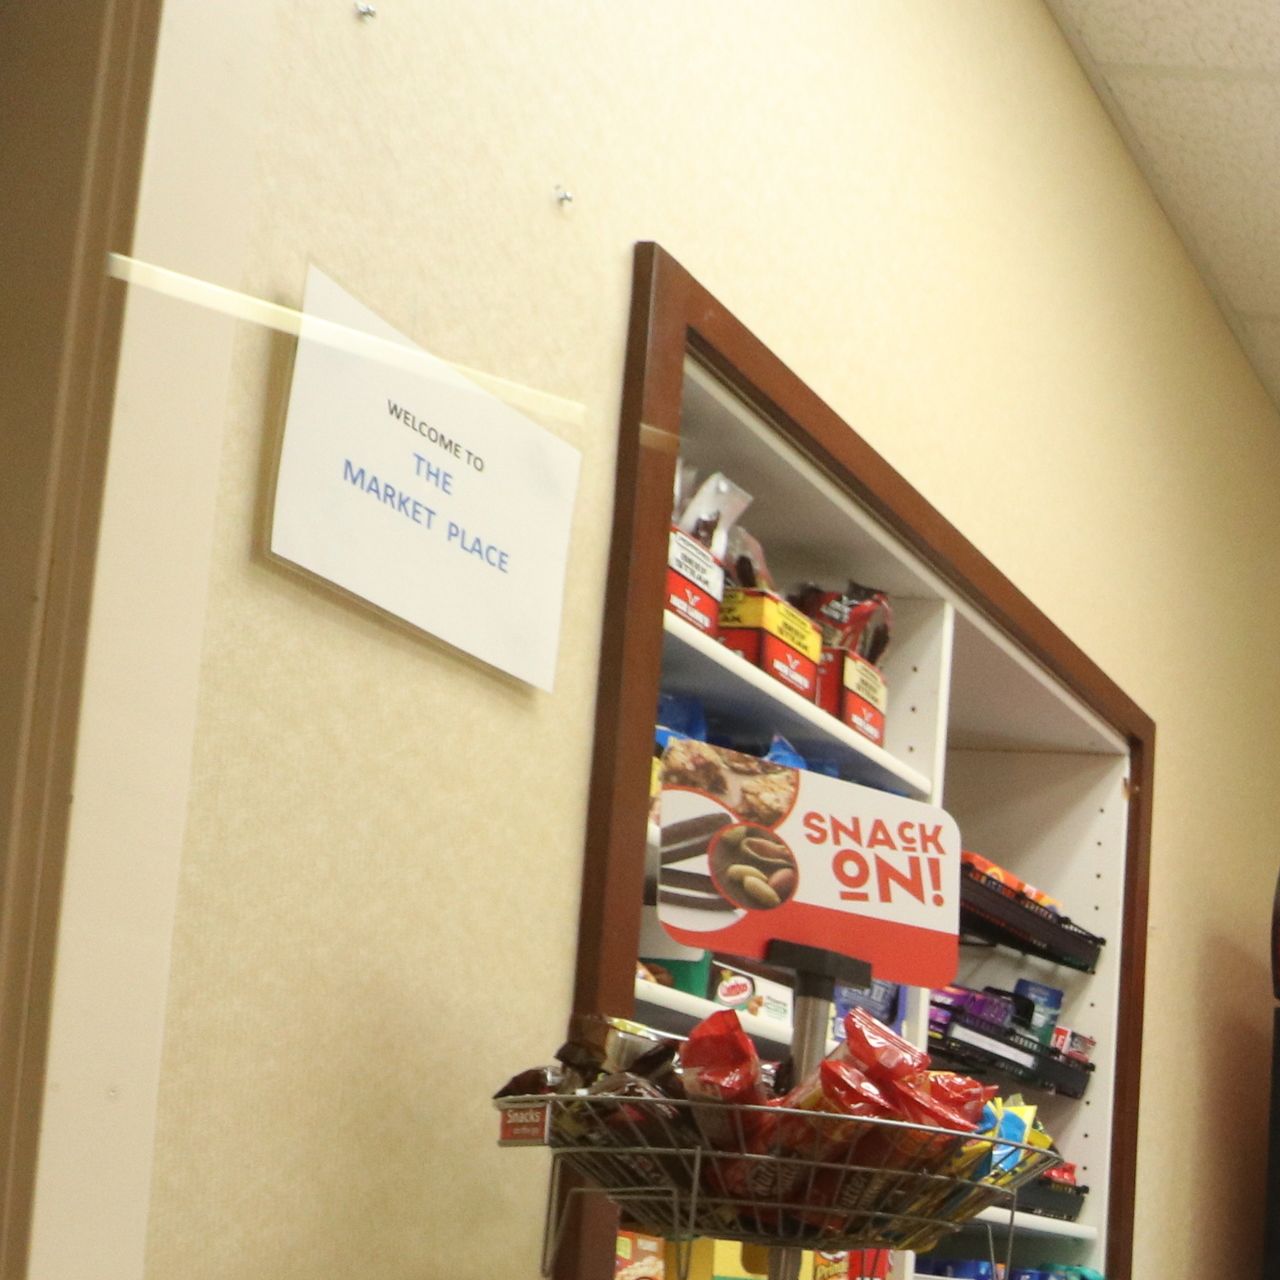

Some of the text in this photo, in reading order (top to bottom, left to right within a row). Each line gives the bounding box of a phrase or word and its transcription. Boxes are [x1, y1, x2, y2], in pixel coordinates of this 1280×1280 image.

[387, 398, 485, 473] WELCOME TO
[412, 452, 454, 497] THE
[342, 458, 510, 574] MARKET PLACE
[803, 810, 947, 856] SNACK
[831, 848, 945, 908] ON!
[507, 1109, 541, 1124] Snacks
